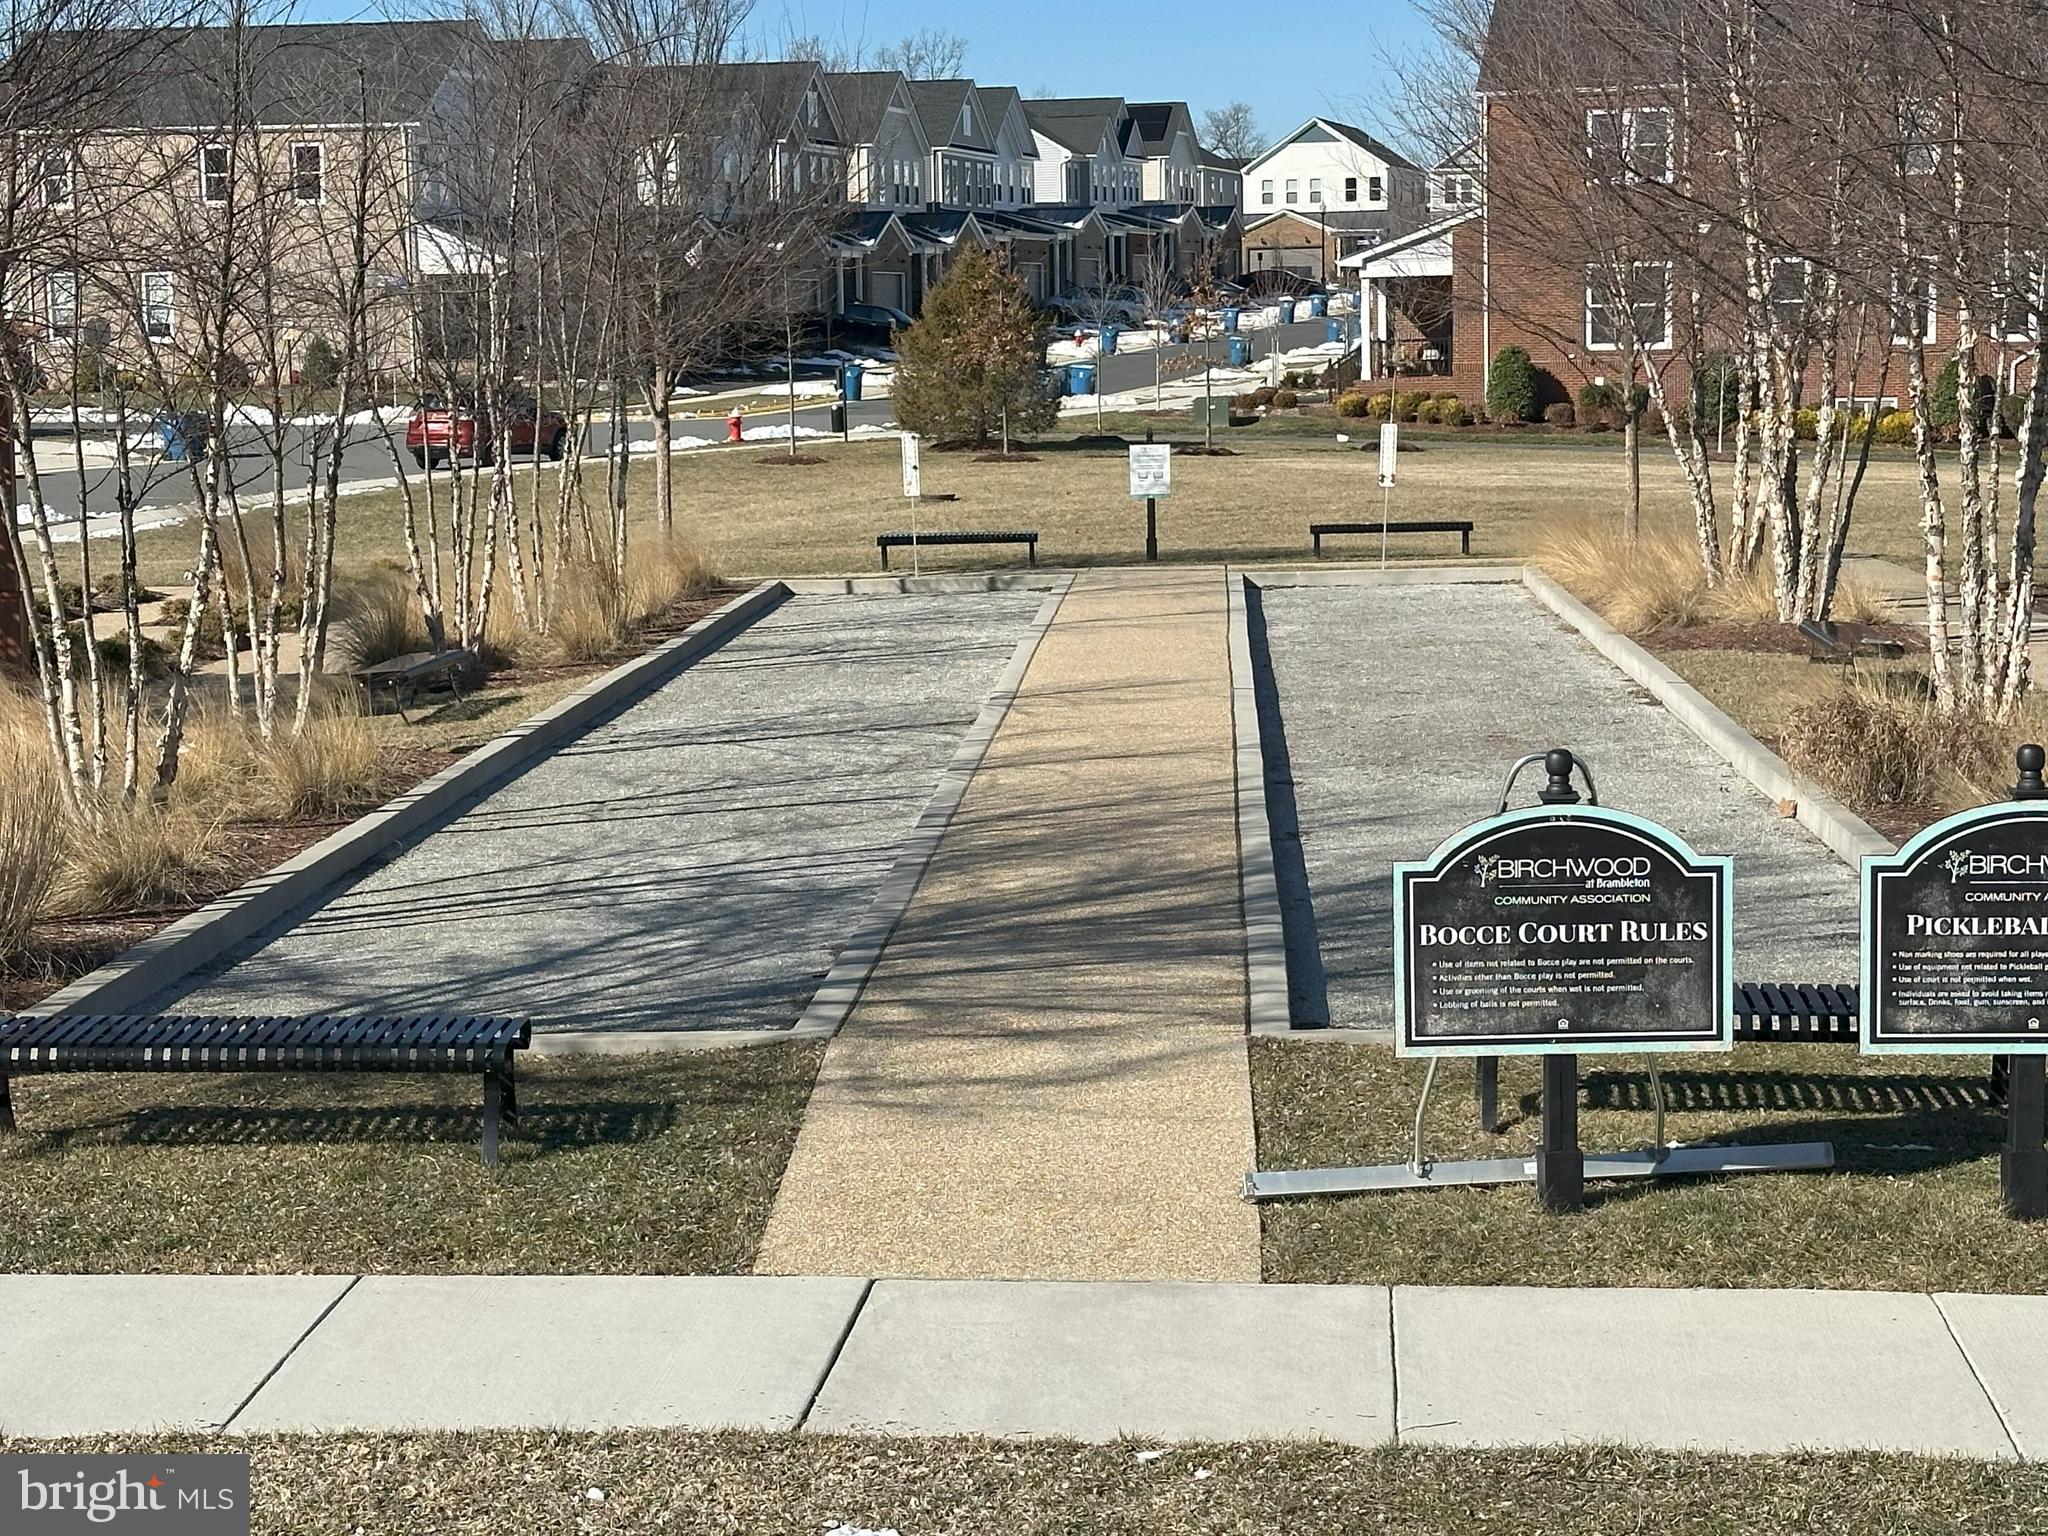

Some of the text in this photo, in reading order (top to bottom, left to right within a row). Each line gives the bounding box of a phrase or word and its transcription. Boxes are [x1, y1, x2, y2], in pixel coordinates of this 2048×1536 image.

[1498, 858, 1650, 878] BIRCHWOOD
[1969, 855, 2048, 874] BIRCH
[1585, 878, 1650, 888] at Brambleton
[1494, 894, 1650, 906] COMMUNITY ASSOCIATION
[1965, 892, 2042, 902] COMMUNITY
[1420, 920, 1708, 946] BOCCE COURT RULES
[1898, 950, 1913, 958] Non
[1914, 951, 1942, 960] marking
[1978, 950, 2007, 959] required
[1439, 960, 1453, 968] Use
[1455, 960, 1462, 968] of
[1500, 959, 1526, 968] related
[1537, 958, 1560, 966] Bocce
[1562, 958, 1577, 967] play
[1606, 957, 1642, 966] permitted
[1922, 963, 1959, 972] equipment
[1960, 962, 1972, 970] not
[1974, 962, 1998, 970] related
[2000, 962, 2008, 970] to
[2008, 962, 2043, 970] Pickleball
[1438, 974, 1473, 982] Activities
[1514, 972, 1536, 980] Bocce
[1538, 972, 1554, 980] play
[1578, 971, 1616, 980] permitted.
[1922, 976, 1940, 984] court
[1962, 976, 1996, 984] permitted
[1439, 988, 1454, 996] Use
[1464, 988, 1498, 996] grooming
[1606, 984, 1644, 994] permitted.
[2000, 990, 2022, 998] taking
[1439, 1001, 1469, 1010] Lobbing
[1480, 1000, 1498, 1008] balls
[1521, 1000, 1560, 1008] permitted.
